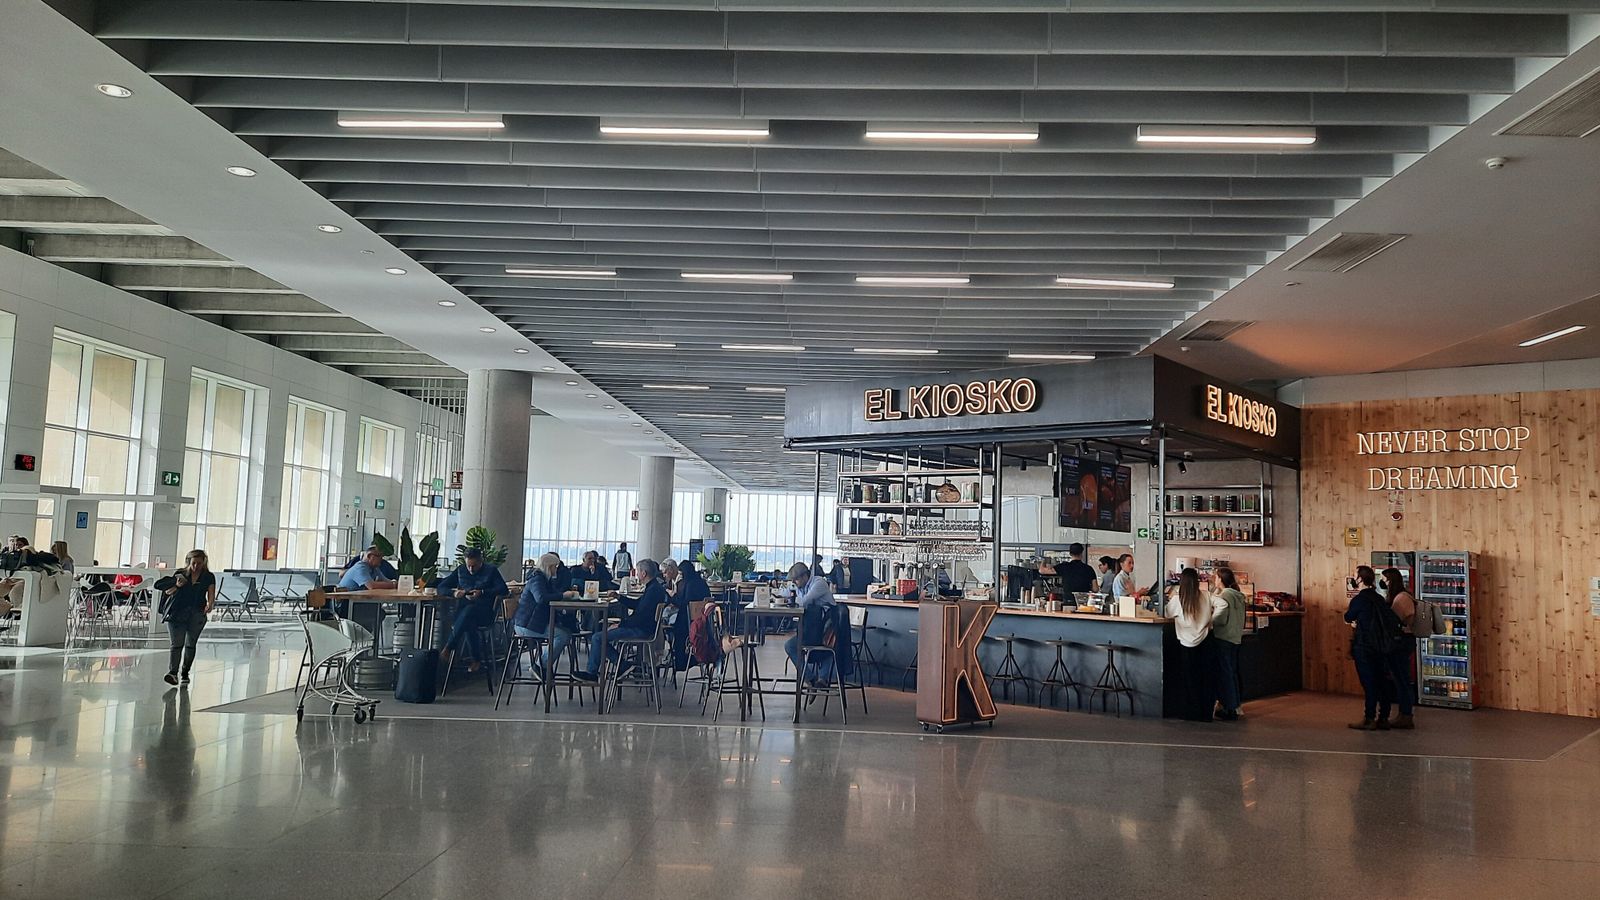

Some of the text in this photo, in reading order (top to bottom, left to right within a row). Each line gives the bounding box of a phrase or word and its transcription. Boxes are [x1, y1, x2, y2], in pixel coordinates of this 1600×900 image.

[864, 377, 1037, 421] EL KIOSKO
[1207, 384, 1277, 437] EL KIOSKO
[1356, 426, 1530, 455] NEVER STOP
[1368, 464, 1520, 491] DREAMING
[941, 604, 998, 722] K
